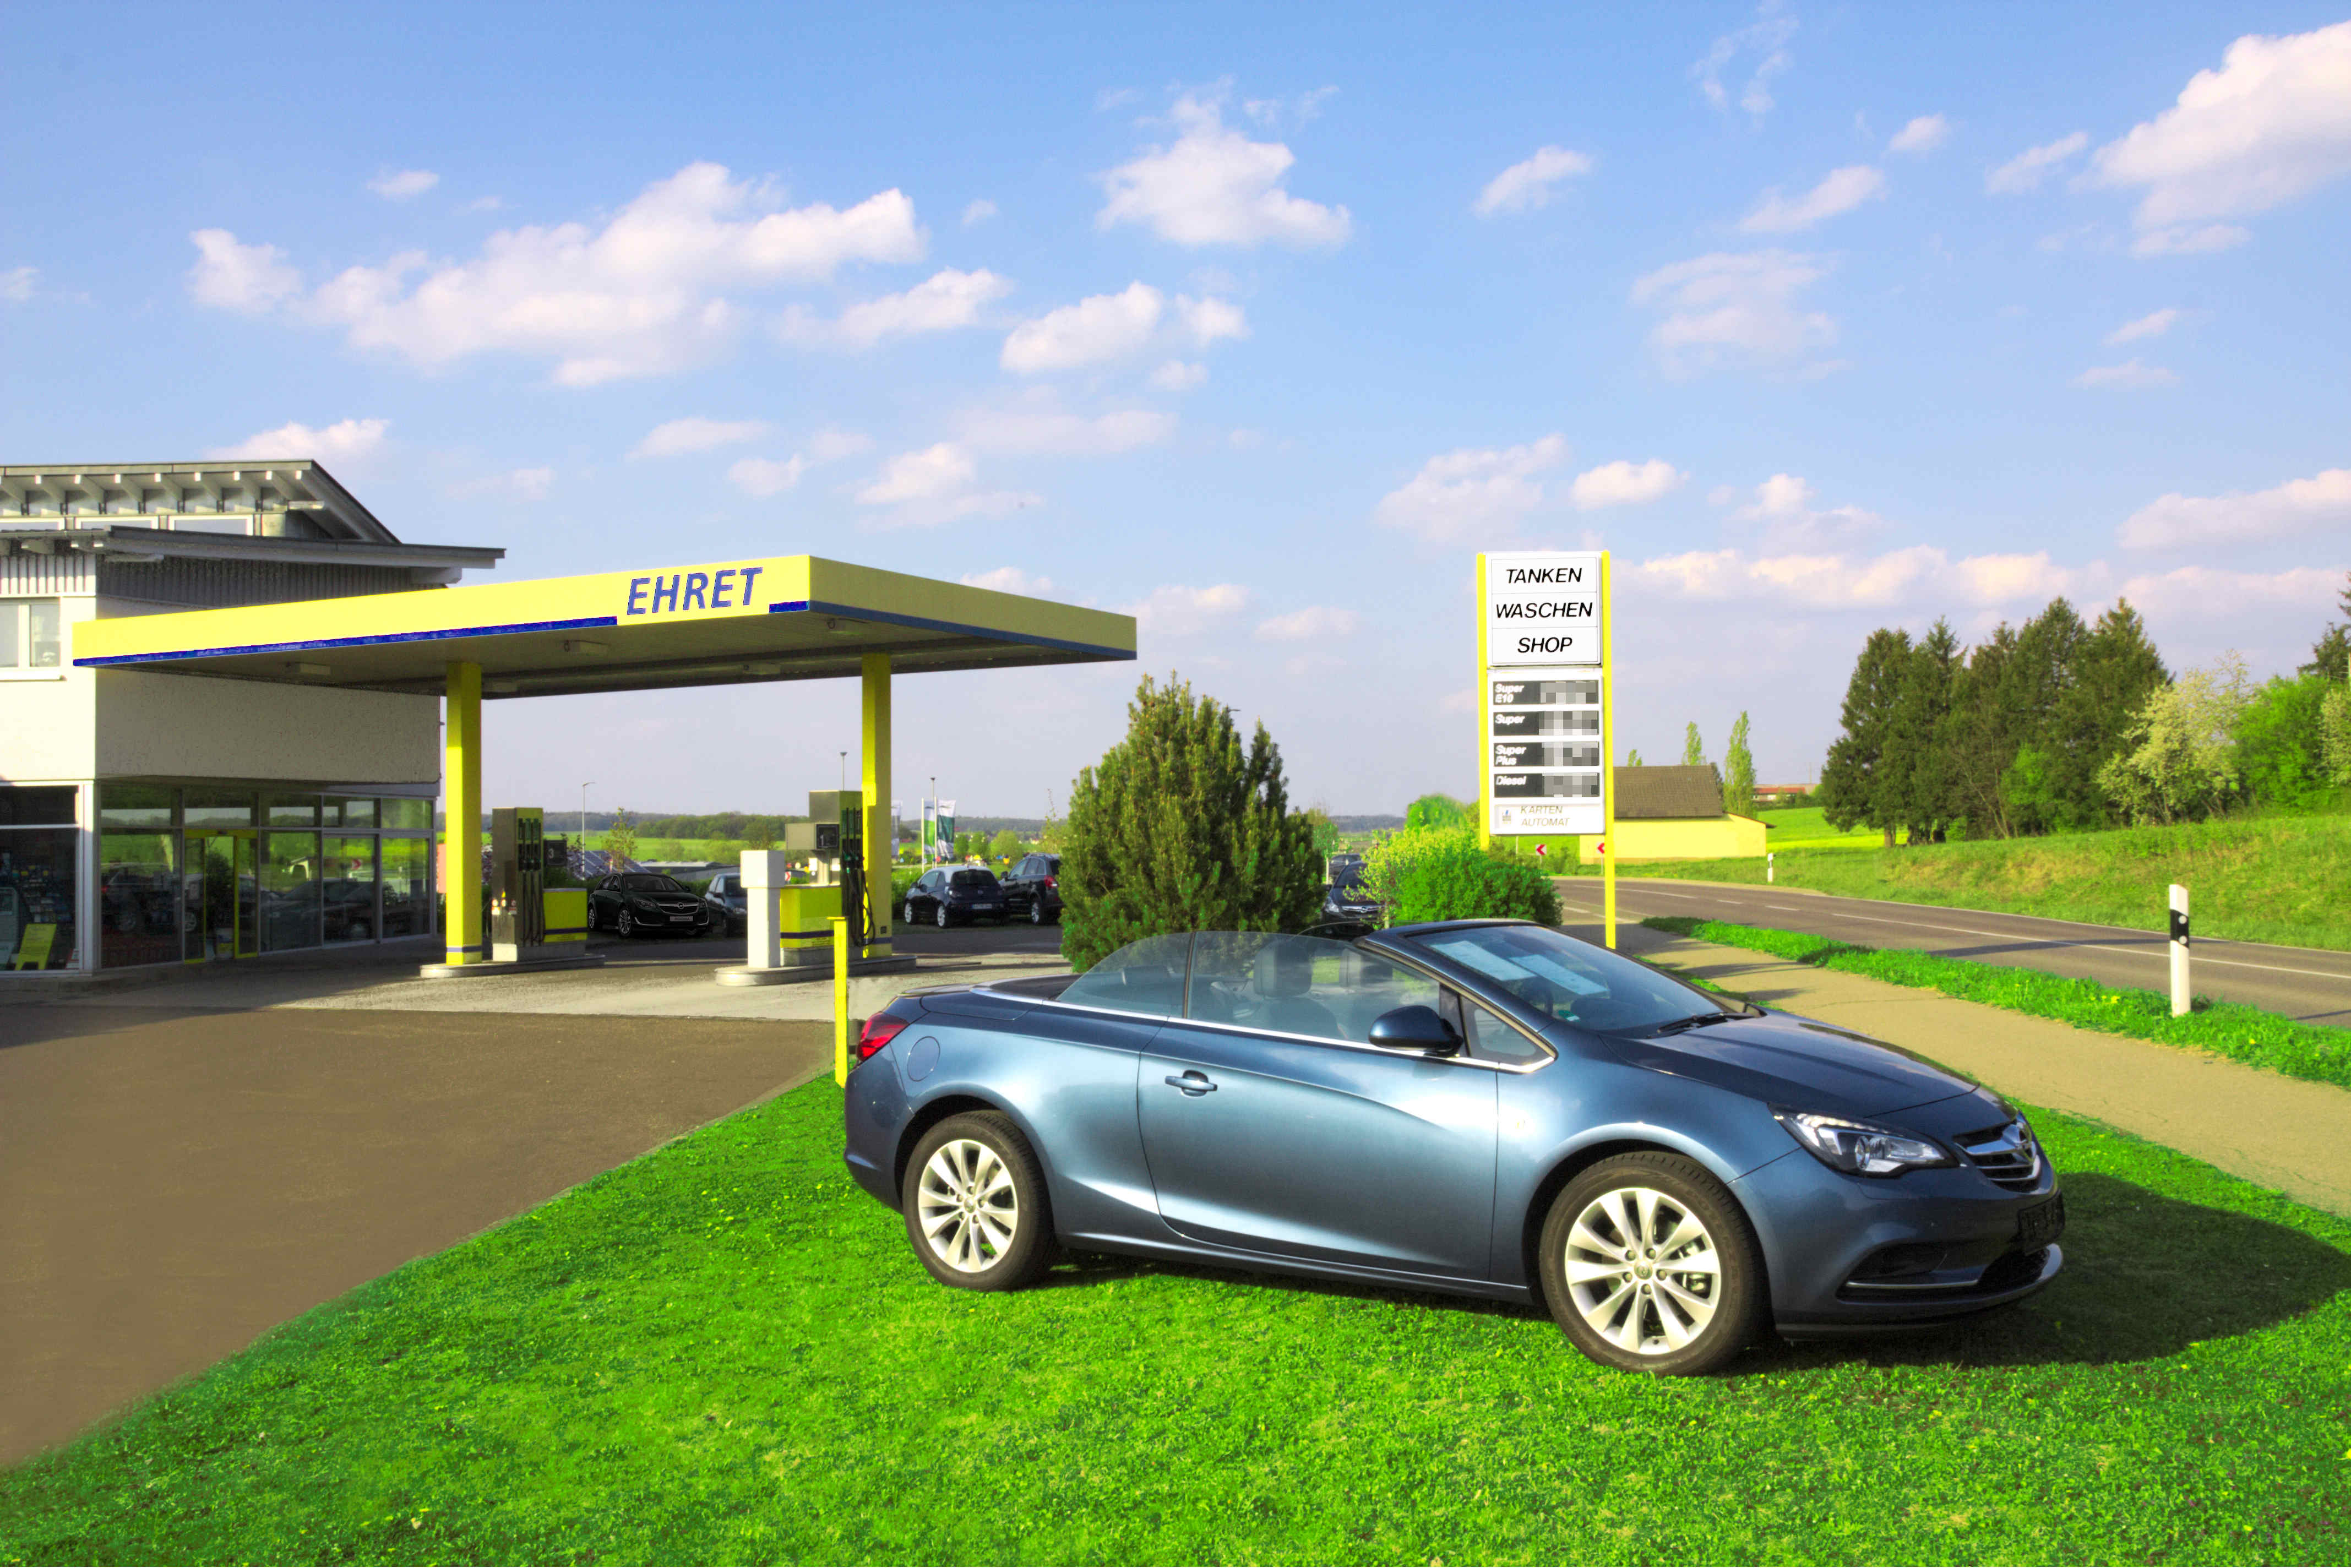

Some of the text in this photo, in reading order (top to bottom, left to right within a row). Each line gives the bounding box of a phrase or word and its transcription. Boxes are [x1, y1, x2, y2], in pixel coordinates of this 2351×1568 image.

[1506, 568, 1582, 583] TANKEN
[627, 567, 763, 615] EHRET
[1496, 602, 1593, 618] WASCHEN
[1517, 637, 1572, 653] SHOP
[1495, 683, 1525, 694] Super
[1495, 694, 1514, 703] E10
[1495, 714, 1525, 725] Super
[1495, 745, 1527, 756] Super
[1495, 755, 1517, 765] Plus
[1496, 776, 1527, 785] Diesel
[1520, 805, 1563, 814] KARTEN
[1521, 818, 1569, 826] AUTOMAT
